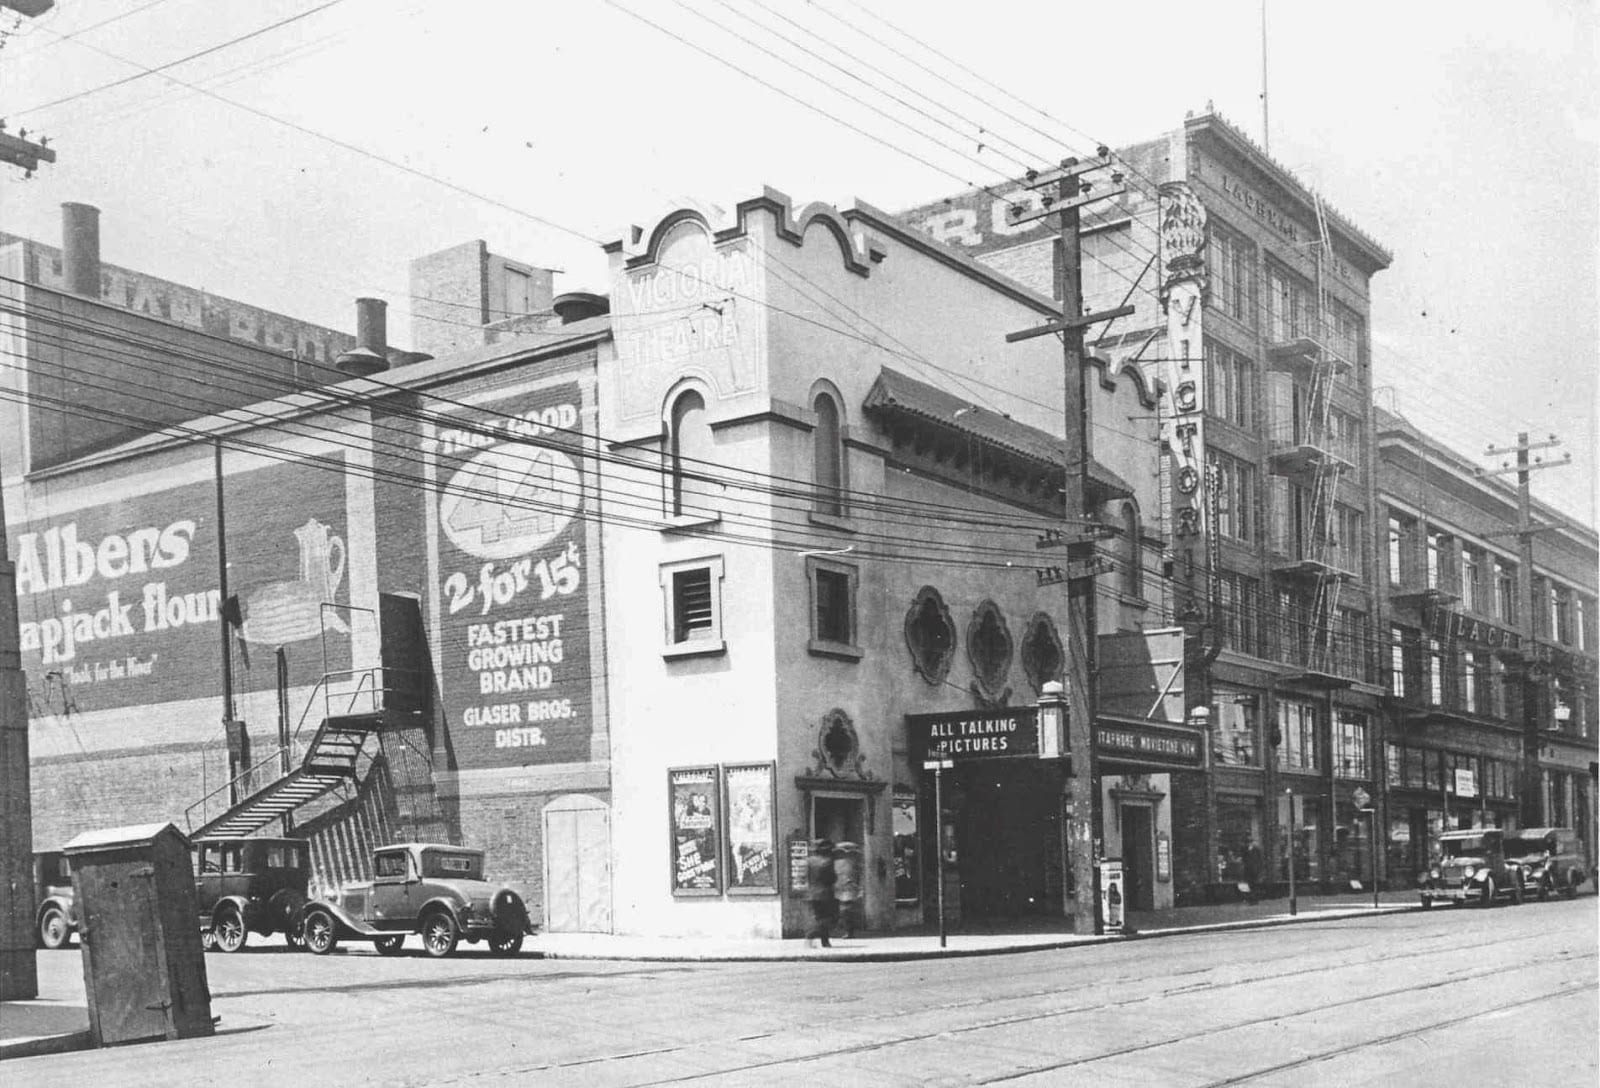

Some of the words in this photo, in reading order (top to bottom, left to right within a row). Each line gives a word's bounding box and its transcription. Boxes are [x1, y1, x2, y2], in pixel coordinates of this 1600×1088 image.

[506, 403, 578, 437] GOOD
[16, 519, 197, 596] Albers
[444, 571, 476, 615] 2
[477, 560, 532, 616] for
[20, 590, 135, 664] apjack
[142, 581, 221, 632] flour
[467, 614, 564, 647] FASTEST
[468, 639, 564, 671] GROWING
[480, 666, 553, 694] BRAND
[463, 703, 522, 726] GLASER
[527, 699, 578, 722] BROS.
[931, 724, 954, 737] ALL
[959, 718, 1017, 735] TALKING
[940, 736, 1008, 753] PICTURES
